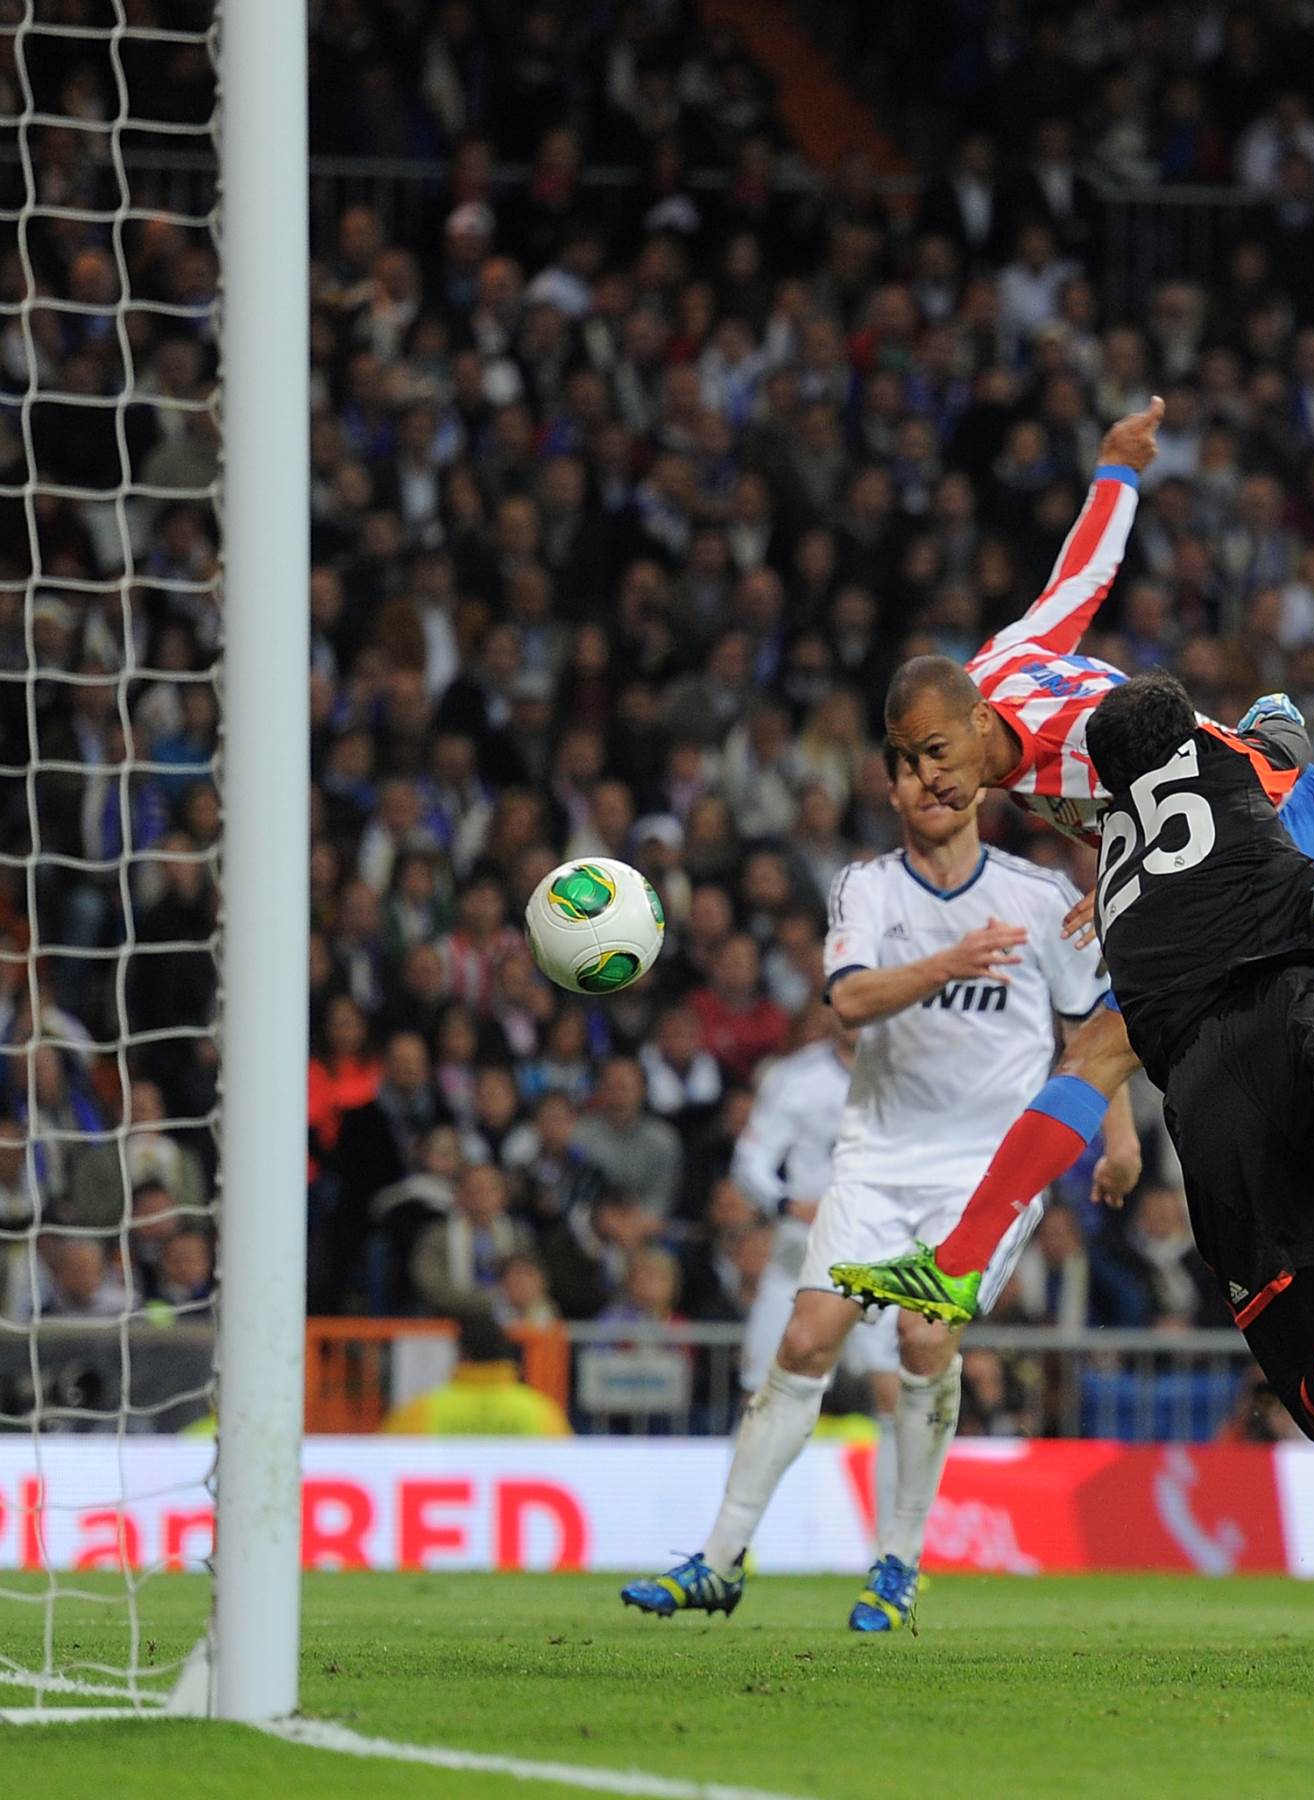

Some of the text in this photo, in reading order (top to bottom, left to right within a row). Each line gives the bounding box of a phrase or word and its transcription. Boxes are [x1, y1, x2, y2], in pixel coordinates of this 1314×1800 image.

[1098, 738, 1216, 940] 25
[921, 983, 1008, 1012] win
[301, 1476, 588, 1572] RED
